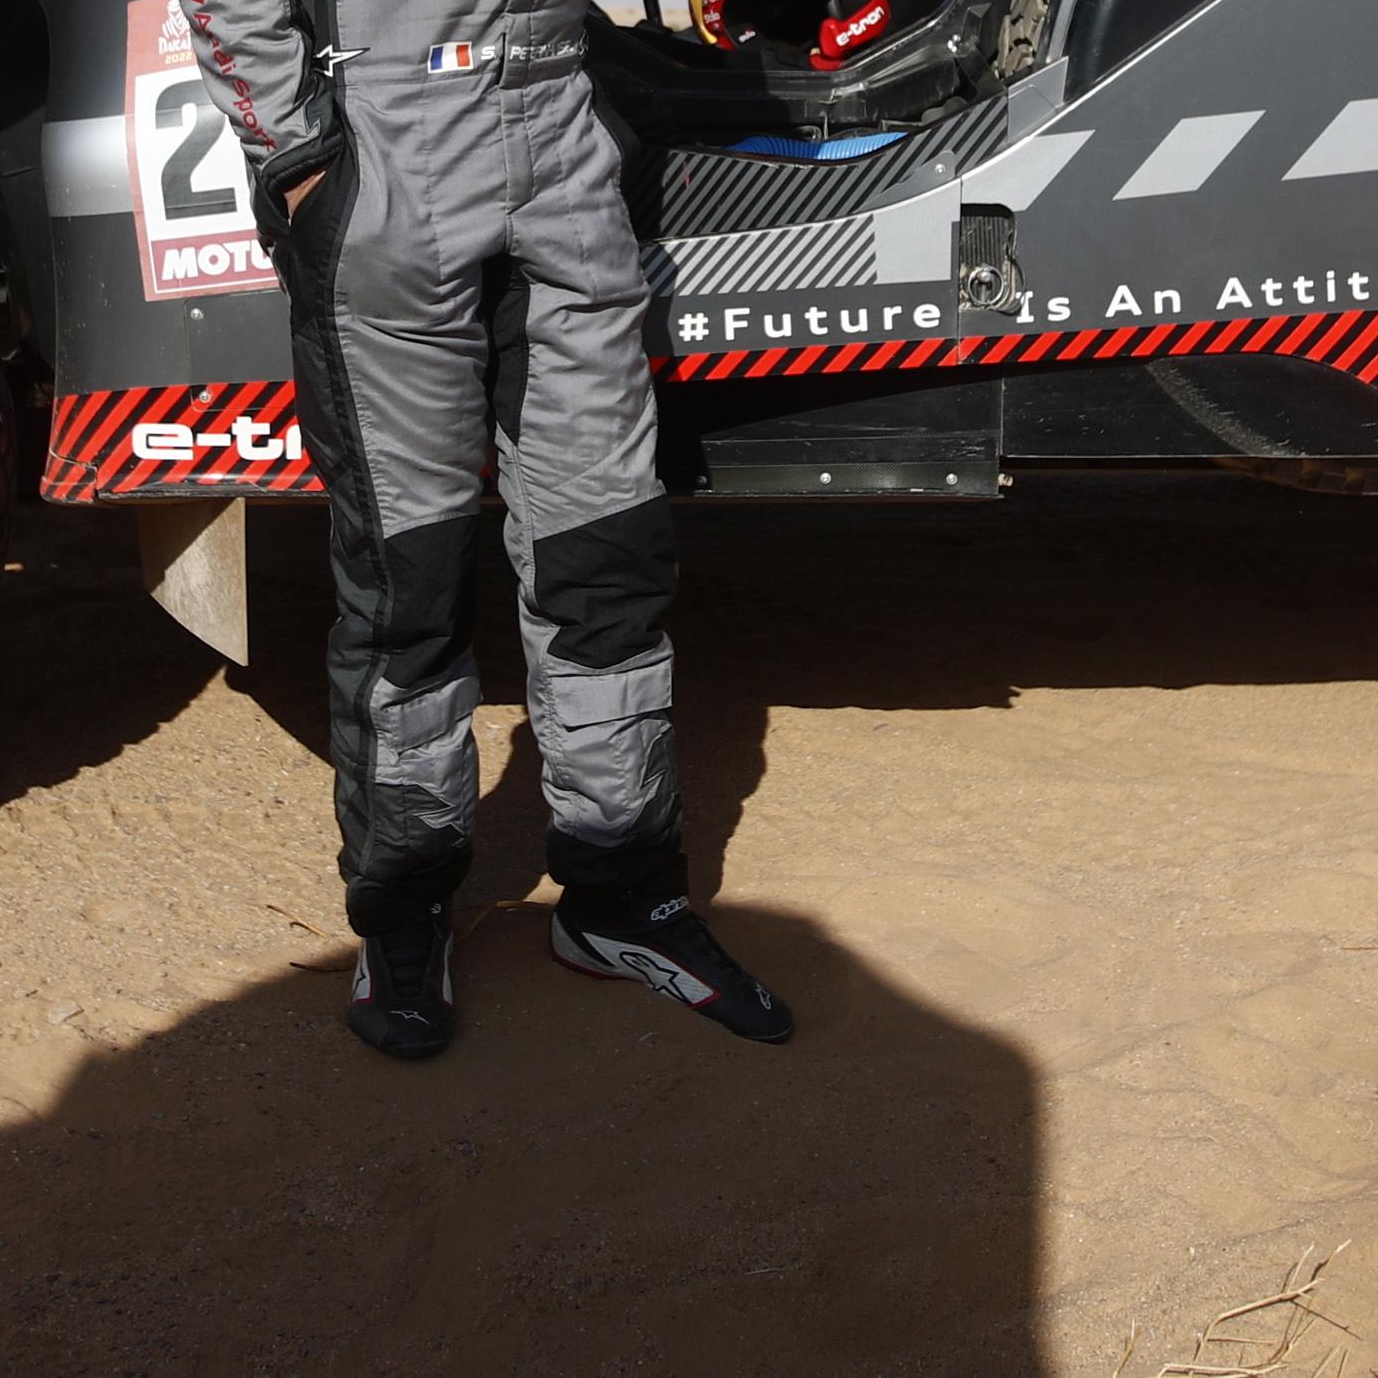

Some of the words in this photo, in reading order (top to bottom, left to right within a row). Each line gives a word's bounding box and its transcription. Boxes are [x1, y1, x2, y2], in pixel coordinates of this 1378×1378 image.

[835, 6, 885, 47] e-tron
[164, 51, 193, 65] 2022
[231, 77, 278, 152] Sport
[678, 303, 942, 343] #Future
[1016, 290, 1072, 324] Is
[1105, 284, 1183, 318] An
